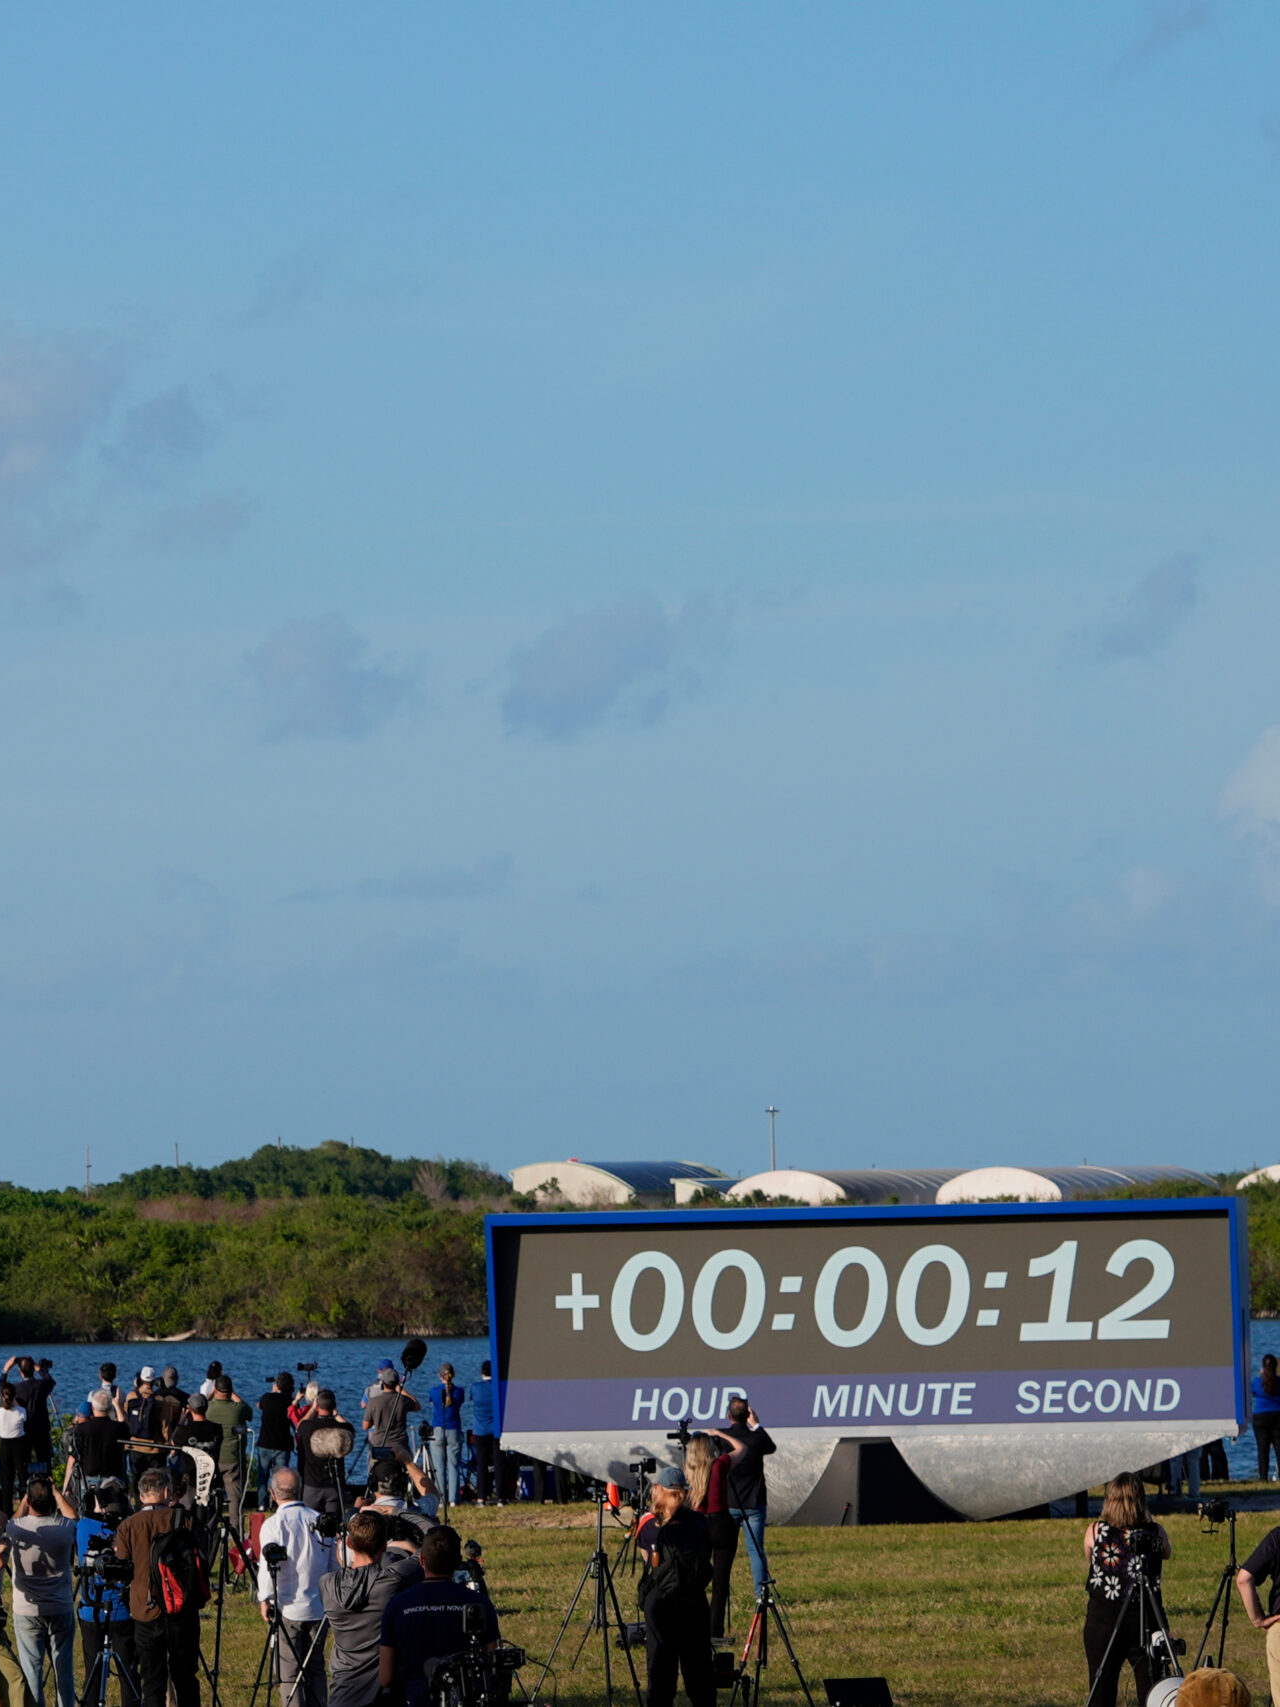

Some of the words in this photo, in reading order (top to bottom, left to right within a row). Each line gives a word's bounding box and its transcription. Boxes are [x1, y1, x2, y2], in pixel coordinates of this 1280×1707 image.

[556, 1239, 1174, 1351] +00:00:12
[812, 1382, 975, 1417] MINUTE
[1016, 1378, 1180, 1413] SECOND
[403, 1605, 445, 1615] SPACEFLIGHT
